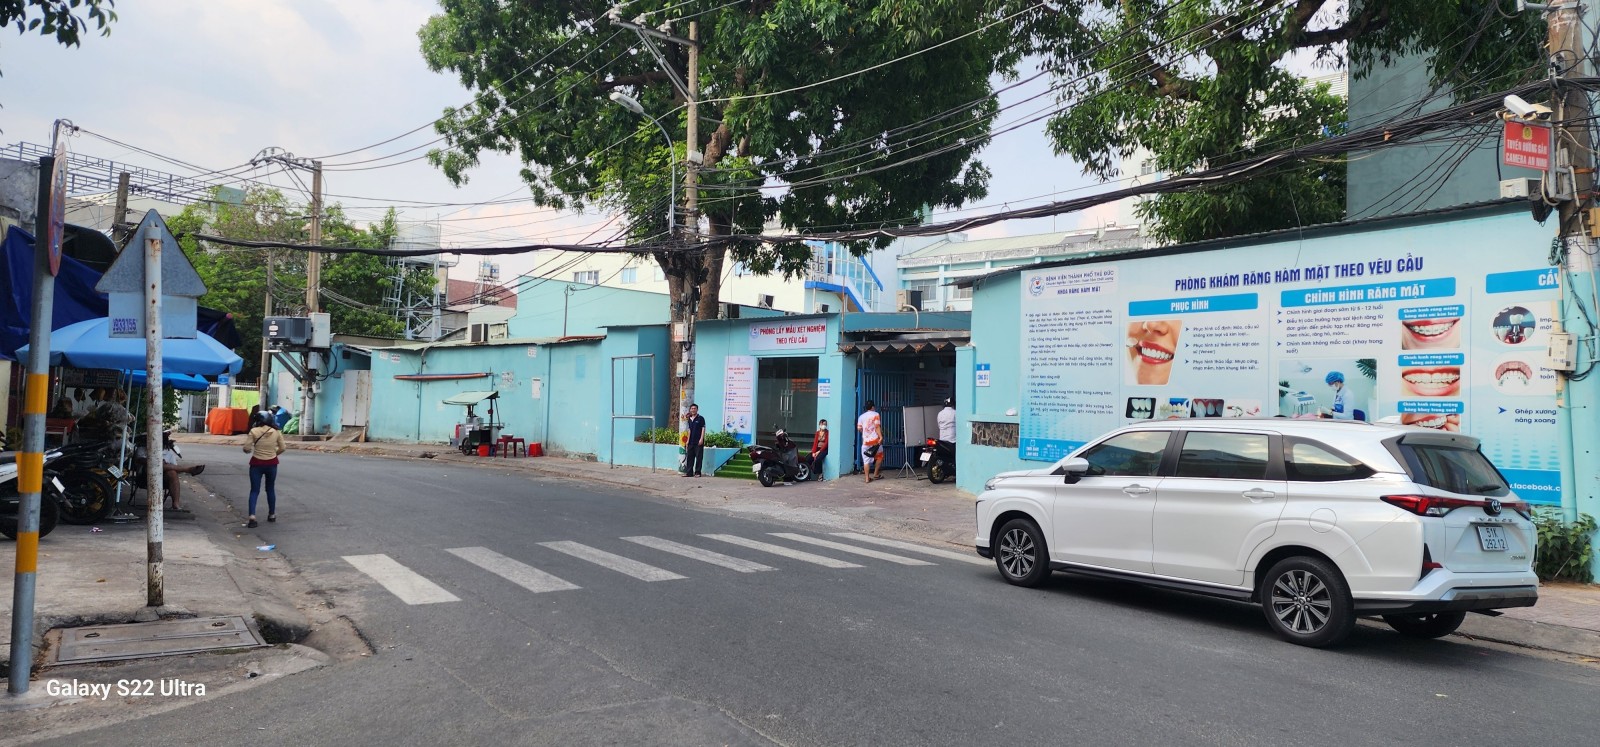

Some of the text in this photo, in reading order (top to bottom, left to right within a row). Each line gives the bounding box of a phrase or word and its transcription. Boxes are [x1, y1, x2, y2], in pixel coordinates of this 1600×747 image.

[1507, 139, 1521, 151] TUYẾN
[1506, 152, 1547, 167] CAMERA AN NINH
[1175, 252, 1424, 290] PHÒNG KHÁM RĂNG HÀM MẶT THEO YÊU CẦU
[1304, 283, 1426, 304] CHỈNH HÌNH RĂNG MẶT
[1170, 299, 1209, 312] PHỤC HÌNH
[760, 323, 826, 335] PHÒNG LẤY MẪU XÉT NGHIỆM
[788, 336, 797, 344] YÊU
[798, 335, 808, 343] CẦU
[1535, 408, 1557, 416] xương
[1485, 528, 1498, 538] 51K
